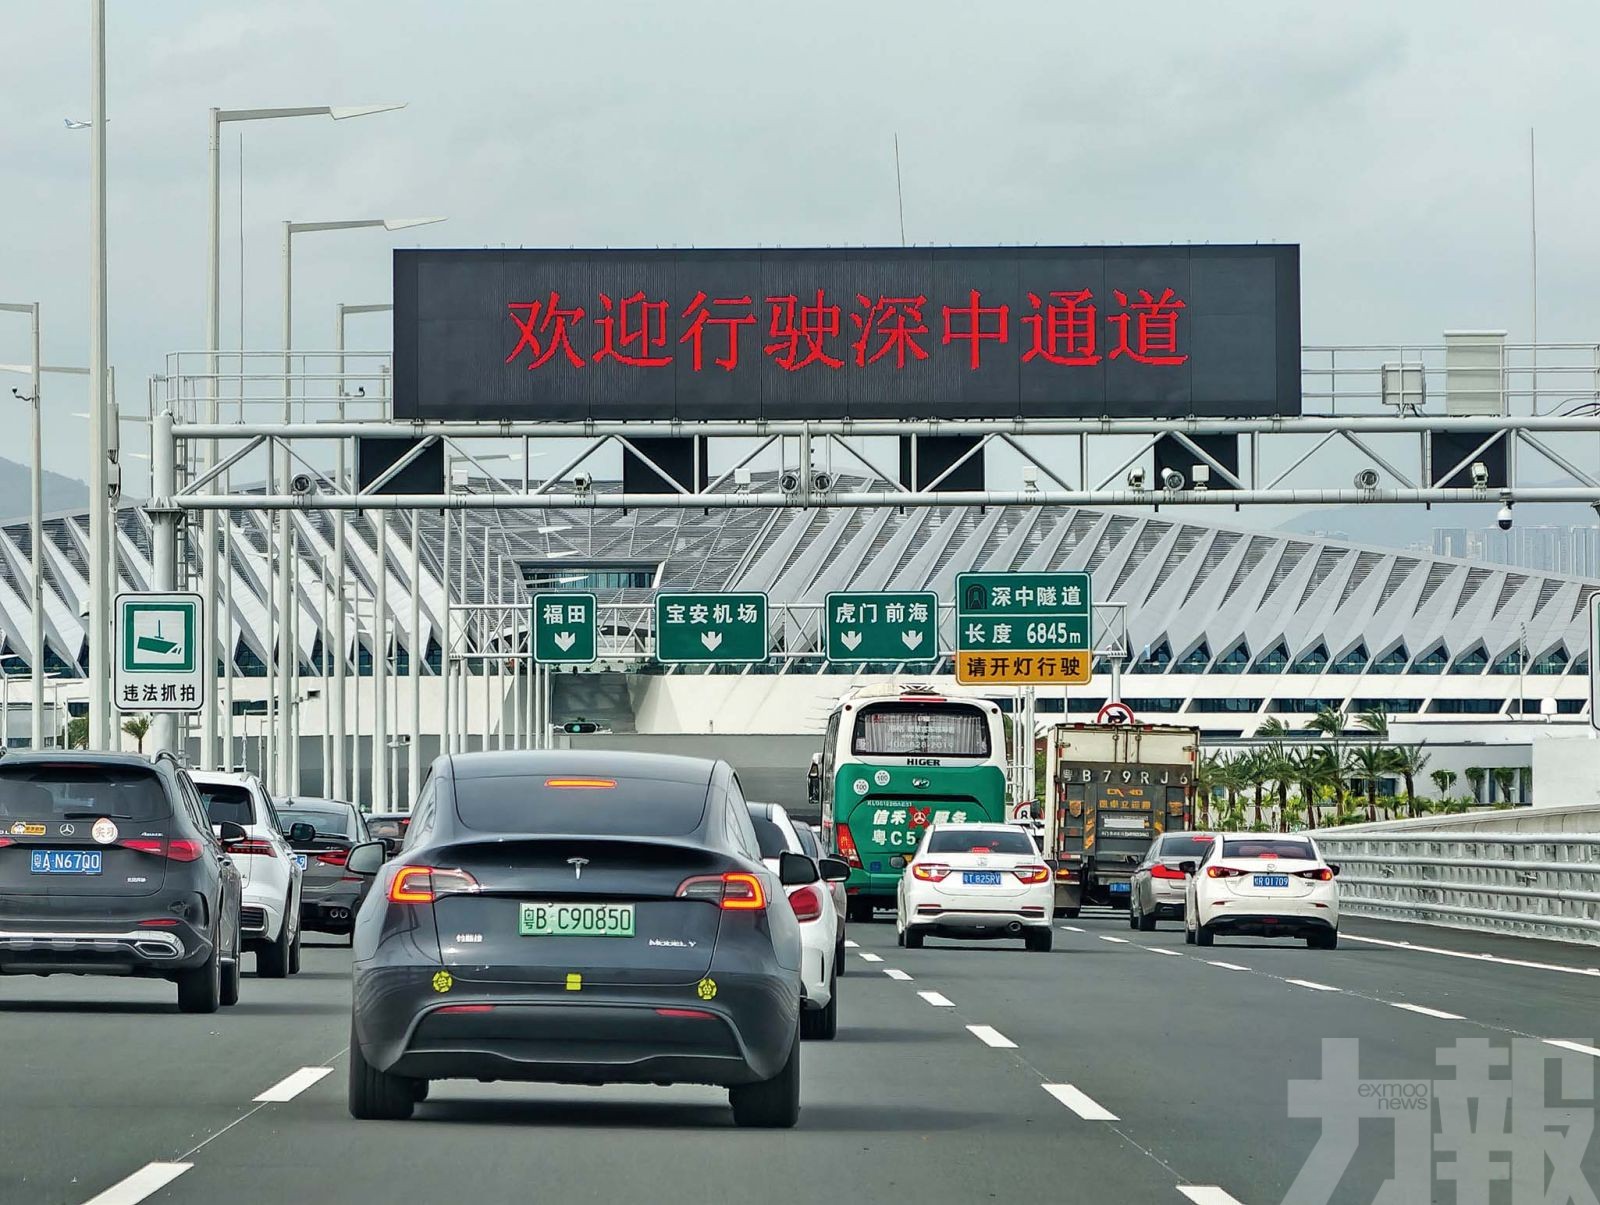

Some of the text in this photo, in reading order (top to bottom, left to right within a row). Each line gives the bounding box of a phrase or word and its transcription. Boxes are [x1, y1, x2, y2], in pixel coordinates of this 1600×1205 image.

[505, 289, 1188, 371] 欢迎行驶深中通道
[991, 586, 1082, 607] 深中隧道
[543, 604, 586, 625] 福田
[666, 603, 758, 624] 宝安机场
[965, 622, 1081, 644] 长度 6845m
[967, 656, 1081, 677] 请开灯行驶
[123, 683, 195, 702] 违法抓拍
[907, 758, 941, 766] HIGER
